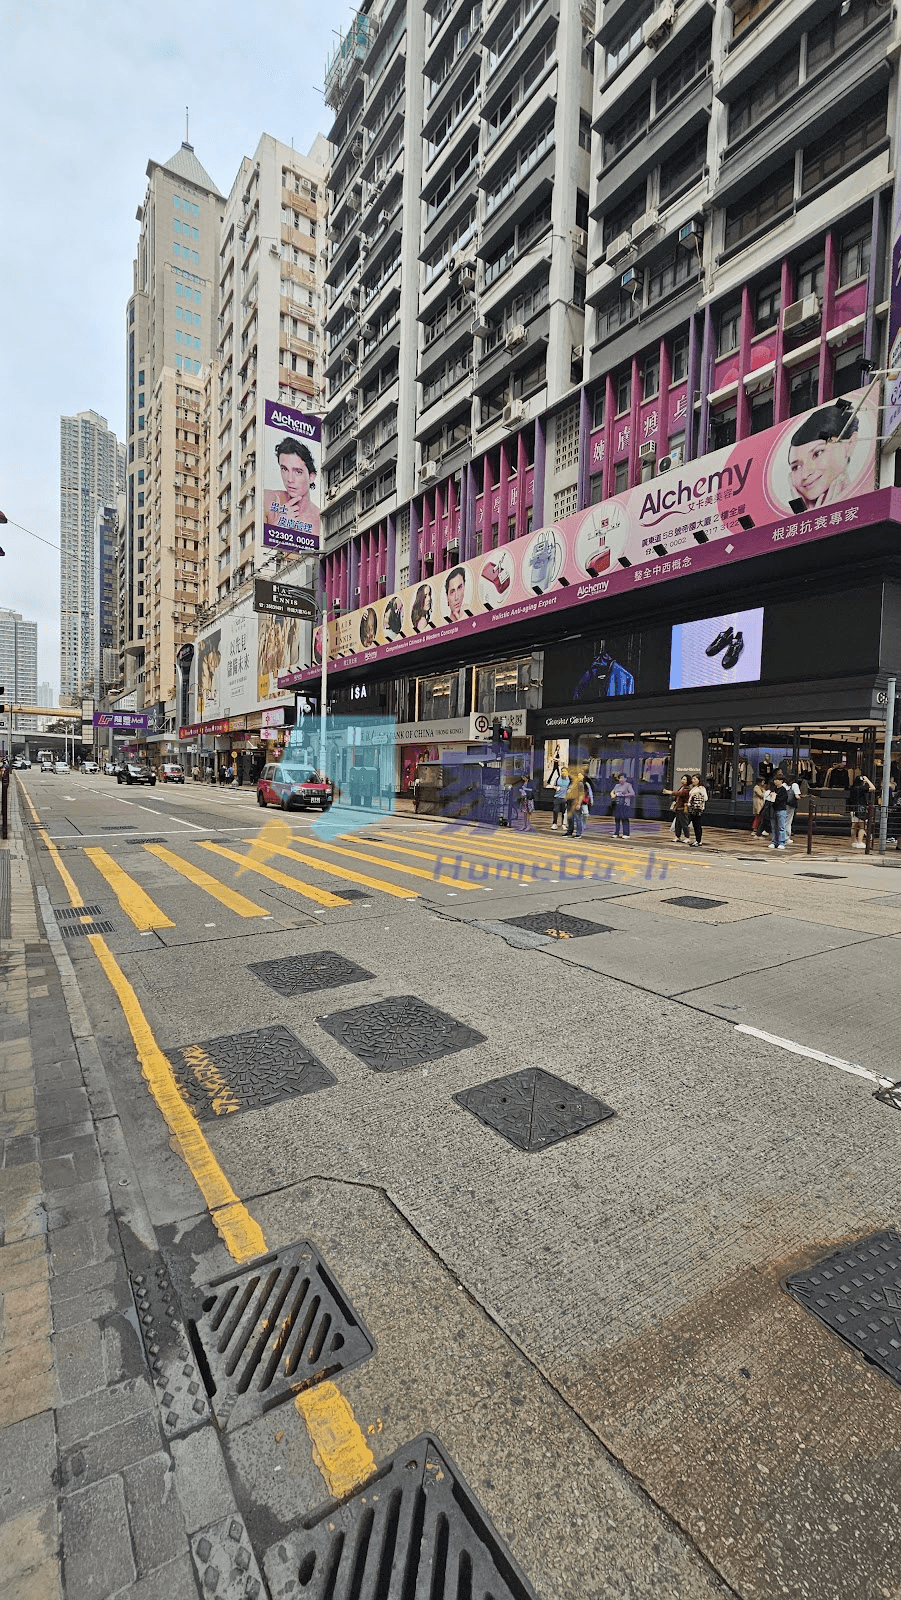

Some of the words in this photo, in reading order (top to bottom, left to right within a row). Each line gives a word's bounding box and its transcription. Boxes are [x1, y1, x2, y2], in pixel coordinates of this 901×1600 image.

[271, 410, 316, 436] Alchemy
[639, 457, 754, 520] Alchemy
[771, 506, 860, 541] 根源抗衰專家
[275, 531, 294, 542] 2302
[296, 536, 315, 547] 0002
[633, 556, 692, 582] 整全中西概念
[577, 580, 610, 596] Alchemy
[272, 594, 298, 606] ENNIS
[491, 612, 510, 621] Holistic
[510, 603, 537, 616] Anti-aging
[538, 597, 557, 608] Expert
[350, 685, 367, 700] ISA
[413, 728, 434, 738] CHINA
